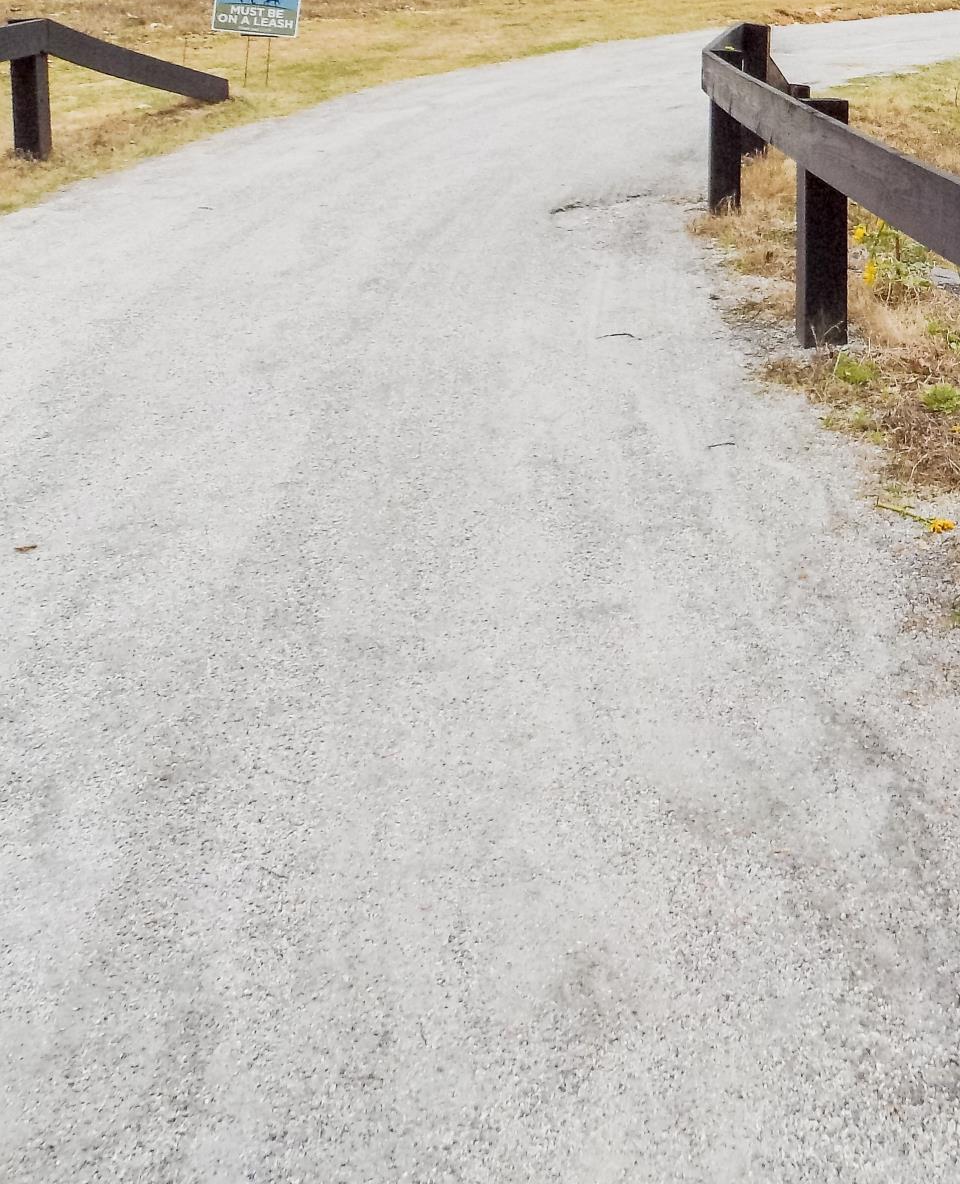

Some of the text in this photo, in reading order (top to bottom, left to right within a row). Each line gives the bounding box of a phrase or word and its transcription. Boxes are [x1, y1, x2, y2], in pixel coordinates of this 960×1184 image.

[230, 5, 285, 19] MUST BE
[217, 13, 238, 24] ON
[241, 16, 250, 25] A
[254, 18, 294, 29] LEASH
